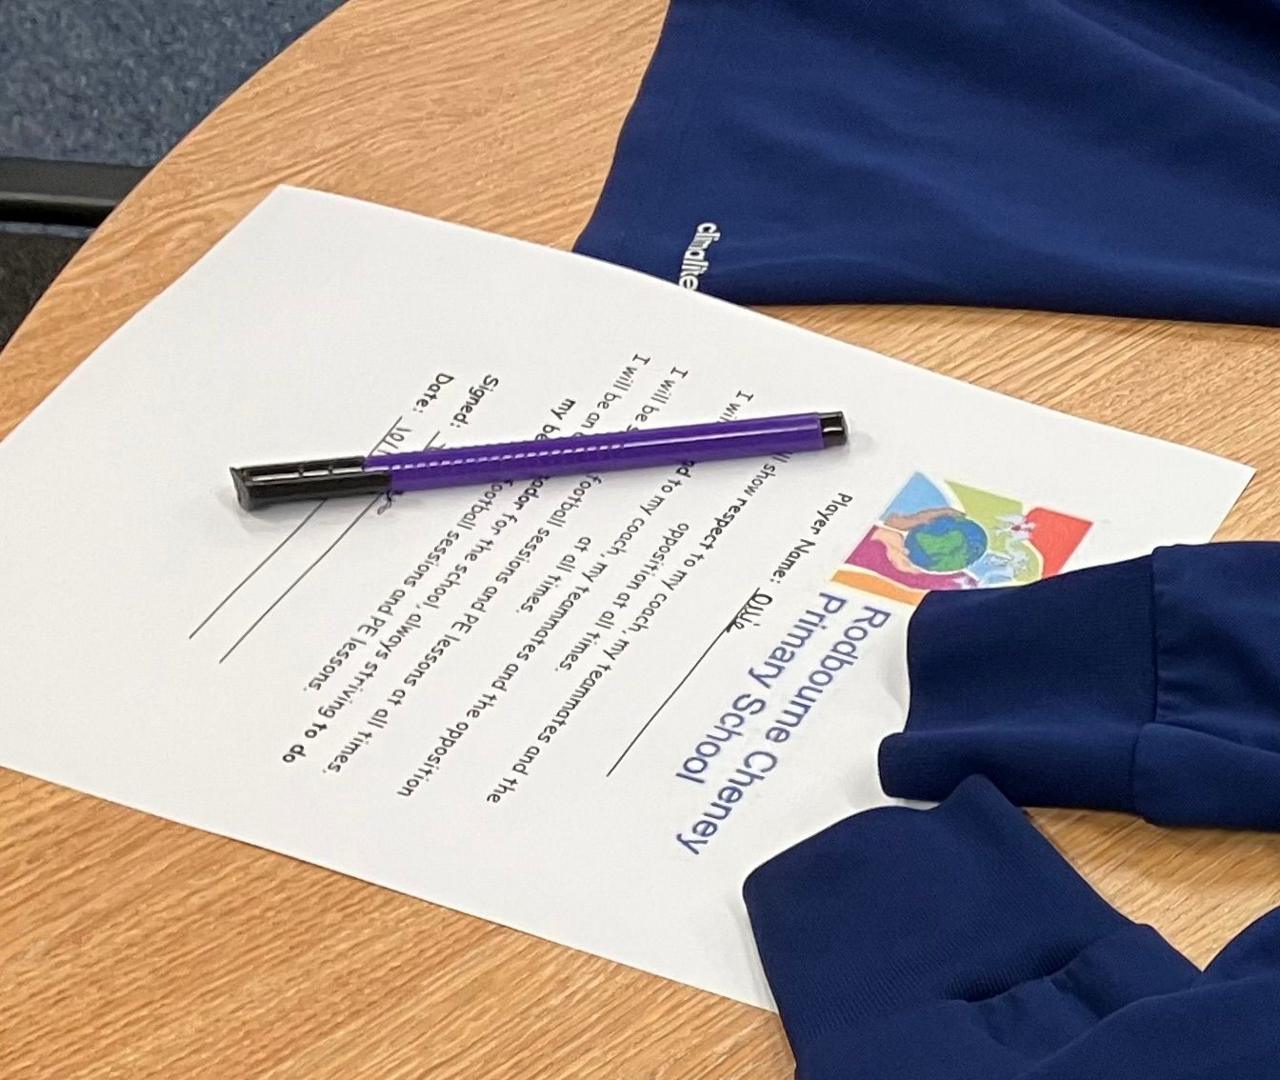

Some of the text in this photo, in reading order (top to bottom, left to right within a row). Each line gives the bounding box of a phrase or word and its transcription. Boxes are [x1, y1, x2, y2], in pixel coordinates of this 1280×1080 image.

[670, 366, 689, 379] I
[412, 372, 455, 414] Date:
[450, 374, 500, 428] Signed:
[650, 379, 675, 405] will
[735, 390, 754, 402] I
[634, 404, 660, 423] be
[660, 479, 682, 494] to
[743, 463, 776, 497] show
[546, 475, 602, 528] football
[639, 495, 666, 517] my
[600, 517, 645, 558] coach,
[699, 497, 748, 551] respect
[769, 492, 854, 584] Player Name:
[282, 353, 651, 764] I will be an for the school, always striving to do
[303, 398, 577, 691] my football sessions and PE lessons.
[495, 527, 550, 585] sessions
[683, 553, 705, 568] to
[516, 536, 592, 613] at all times.
[581, 562, 608, 583] my
[660, 569, 688, 591] my
[470, 586, 498, 613] and
[555, 522, 690, 672] opposition at all times.
[621, 592, 668, 635] coach,
[450, 613, 480, 634] PE
[516, 586, 590, 662] teammates
[403, 634, 461, 687] lessons
[602, 638, 630, 661] my
[490, 663, 519, 692] and
[675, 592, 848, 784] Primary School
[387, 689, 406, 706] at
[466, 693, 498, 719] the
[537, 664, 612, 744] teammates
[367, 708, 389, 729] all
[676, 605, 892, 855] Rodbourne Cheney
[322, 731, 373, 773] times.
[397, 721, 469, 797] opposition
[511, 745, 541, 776] and
[486, 777, 518, 804] the
